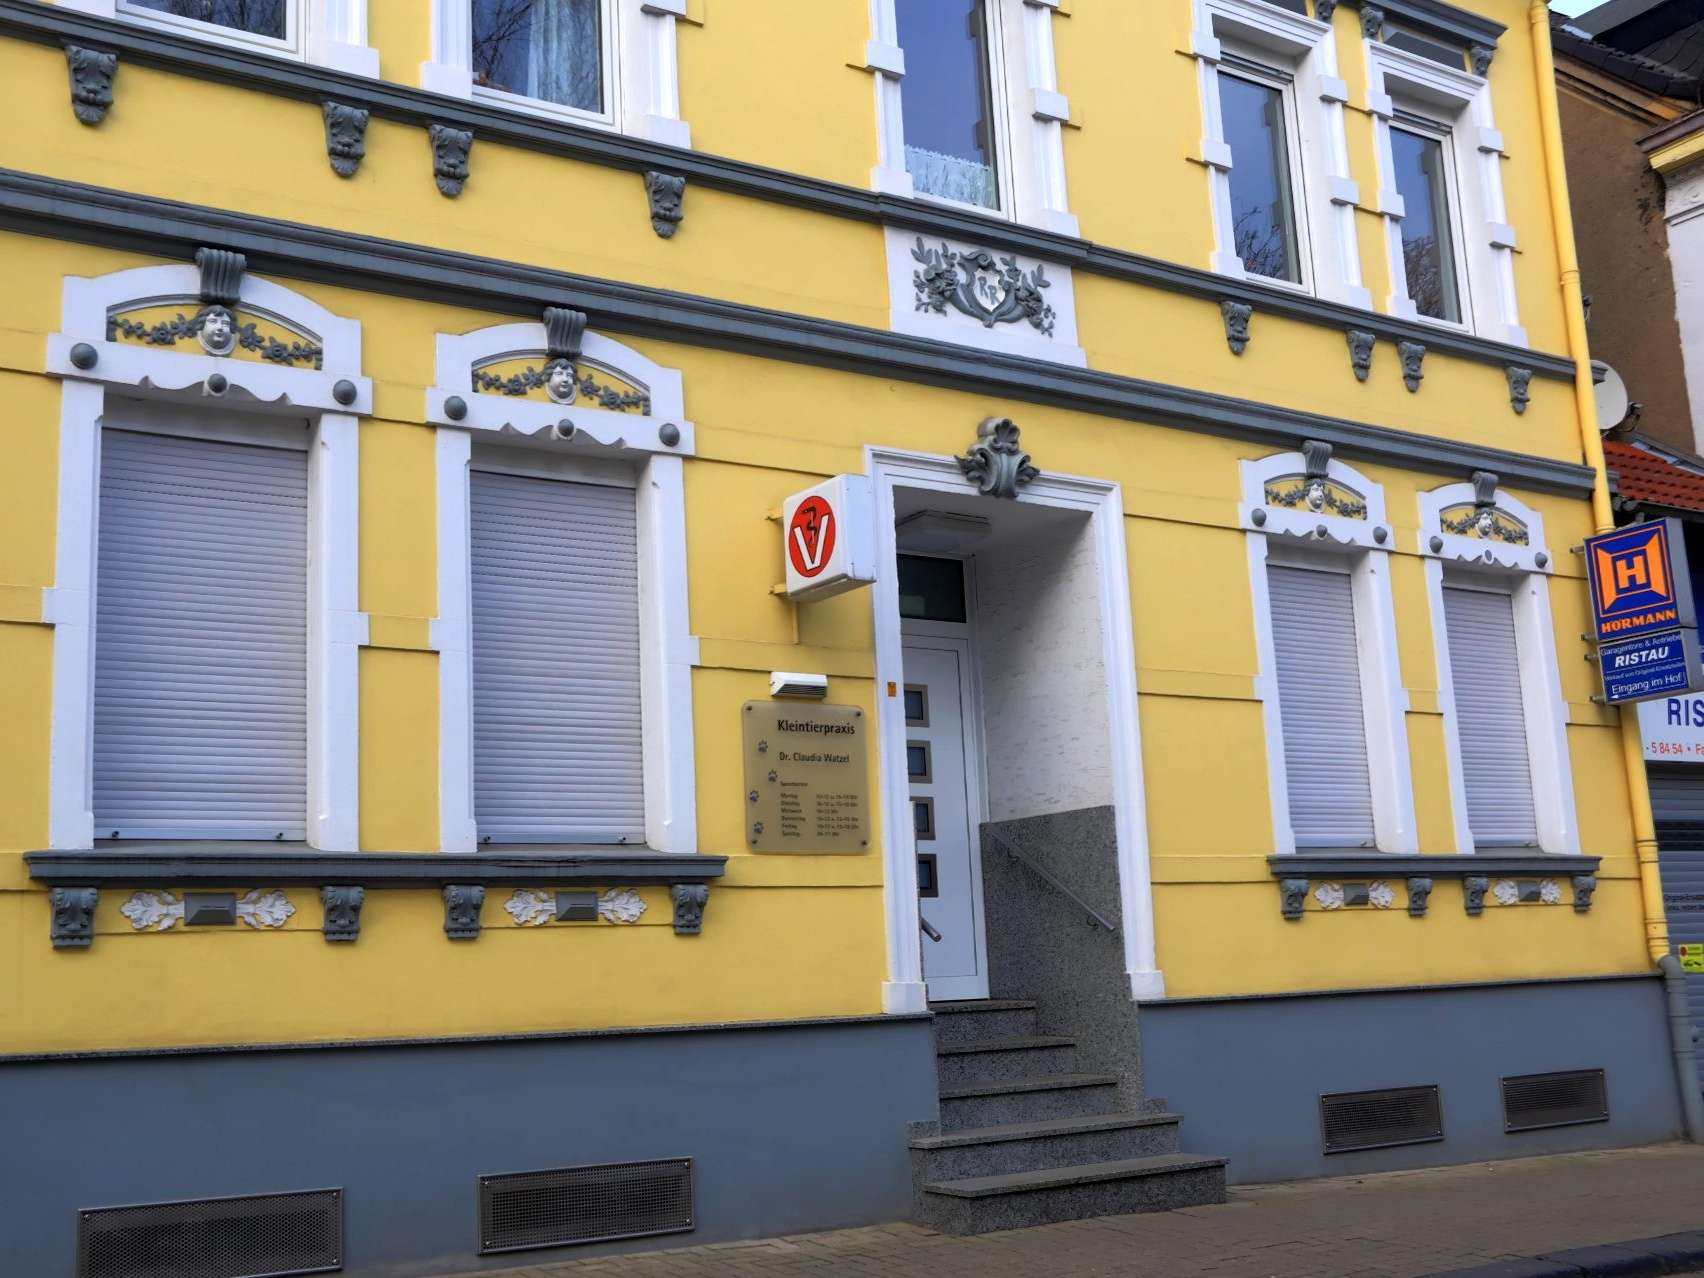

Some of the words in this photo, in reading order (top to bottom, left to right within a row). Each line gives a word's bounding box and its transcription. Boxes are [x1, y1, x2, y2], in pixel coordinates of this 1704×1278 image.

[1616, 555, 1647, 589] H
[1615, 646, 1669, 668] RISTAU
[1611, 681, 1650, 695] Eingang
[1651, 678, 1663, 686] im
[1665, 671, 1683, 684] Hof
[777, 719, 855, 736] Kleintierpraxis
[779, 751, 791, 761] Dr.
[793, 752, 822, 762] Claudia
